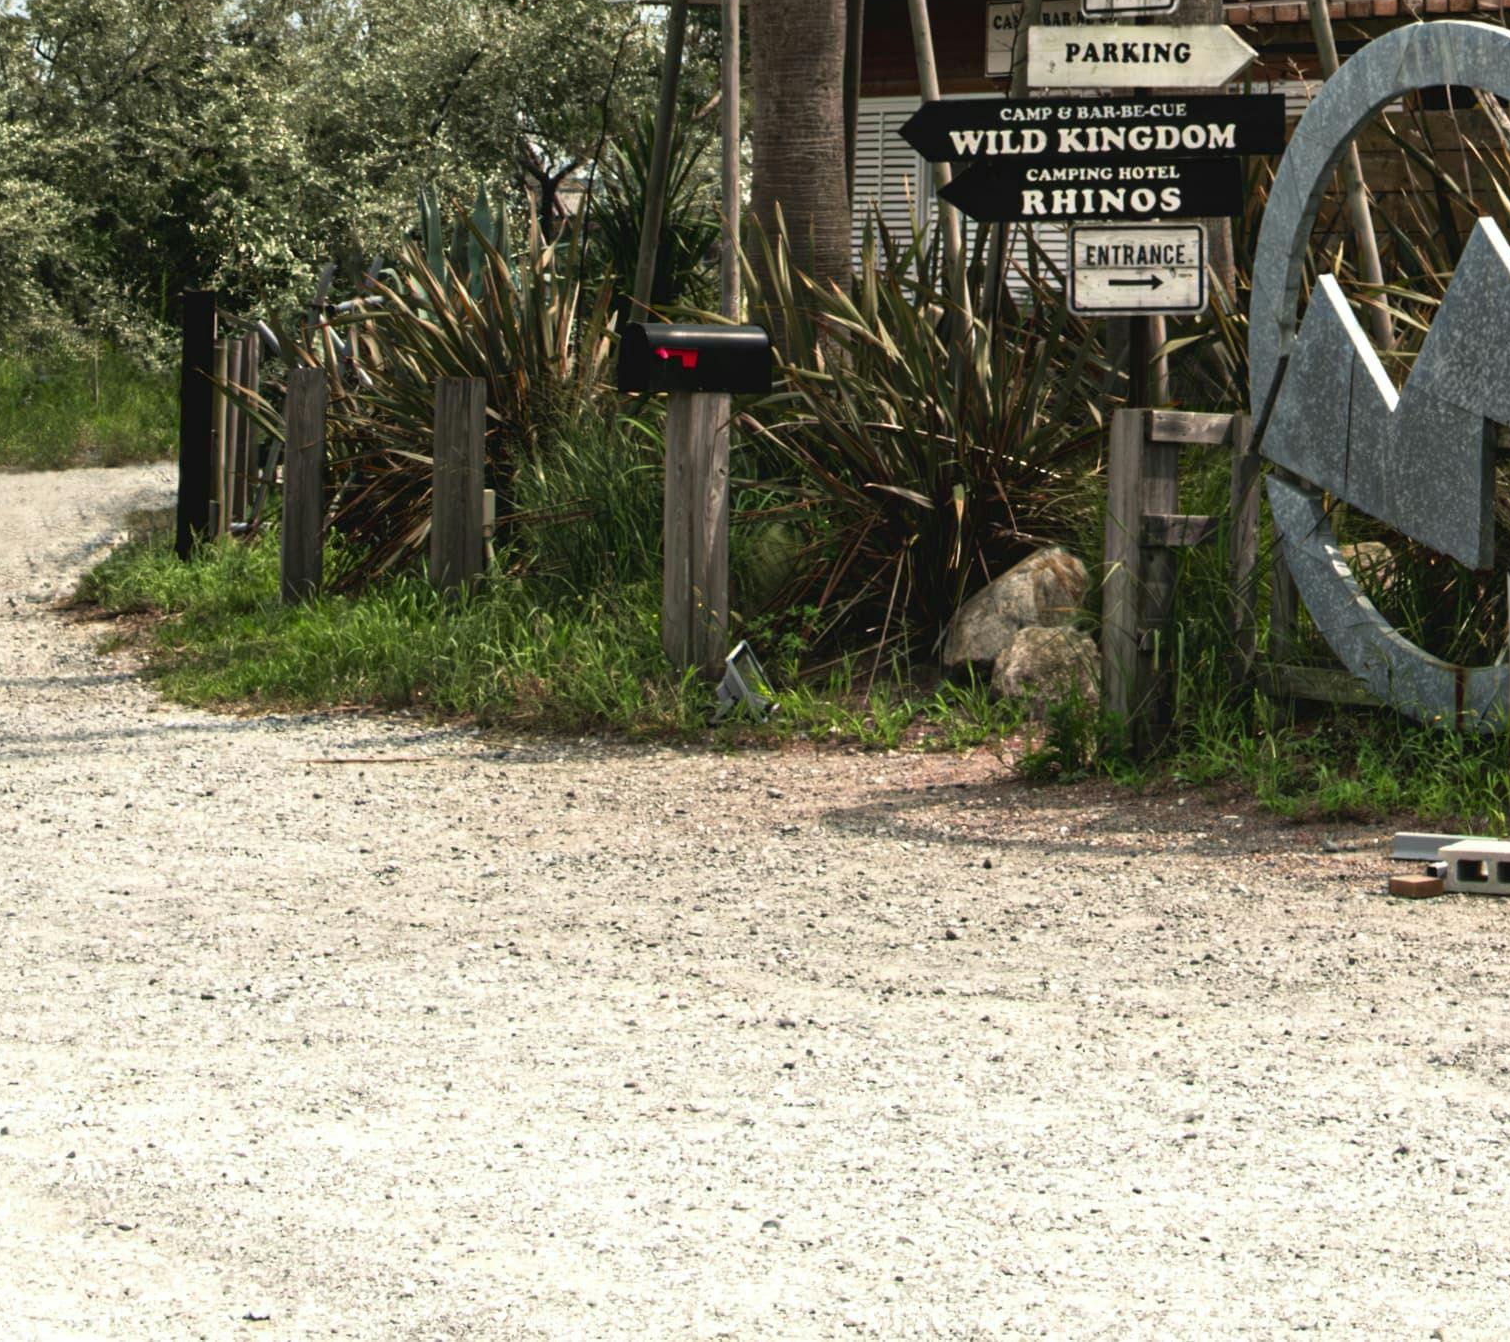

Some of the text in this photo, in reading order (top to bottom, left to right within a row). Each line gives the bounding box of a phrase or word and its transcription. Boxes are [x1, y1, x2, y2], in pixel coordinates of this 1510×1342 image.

[1065, 42, 1191, 64] PARKING
[1000, 103, 1187, 121] CAMP & BAR-BE-CUE
[949, 123, 1236, 155] WILD KINGDOM
[1026, 166, 1180, 182] CAMPING HOTEL
[1021, 187, 1182, 215] RHINOS
[1086, 244, 1186, 266] ENTRANCE
